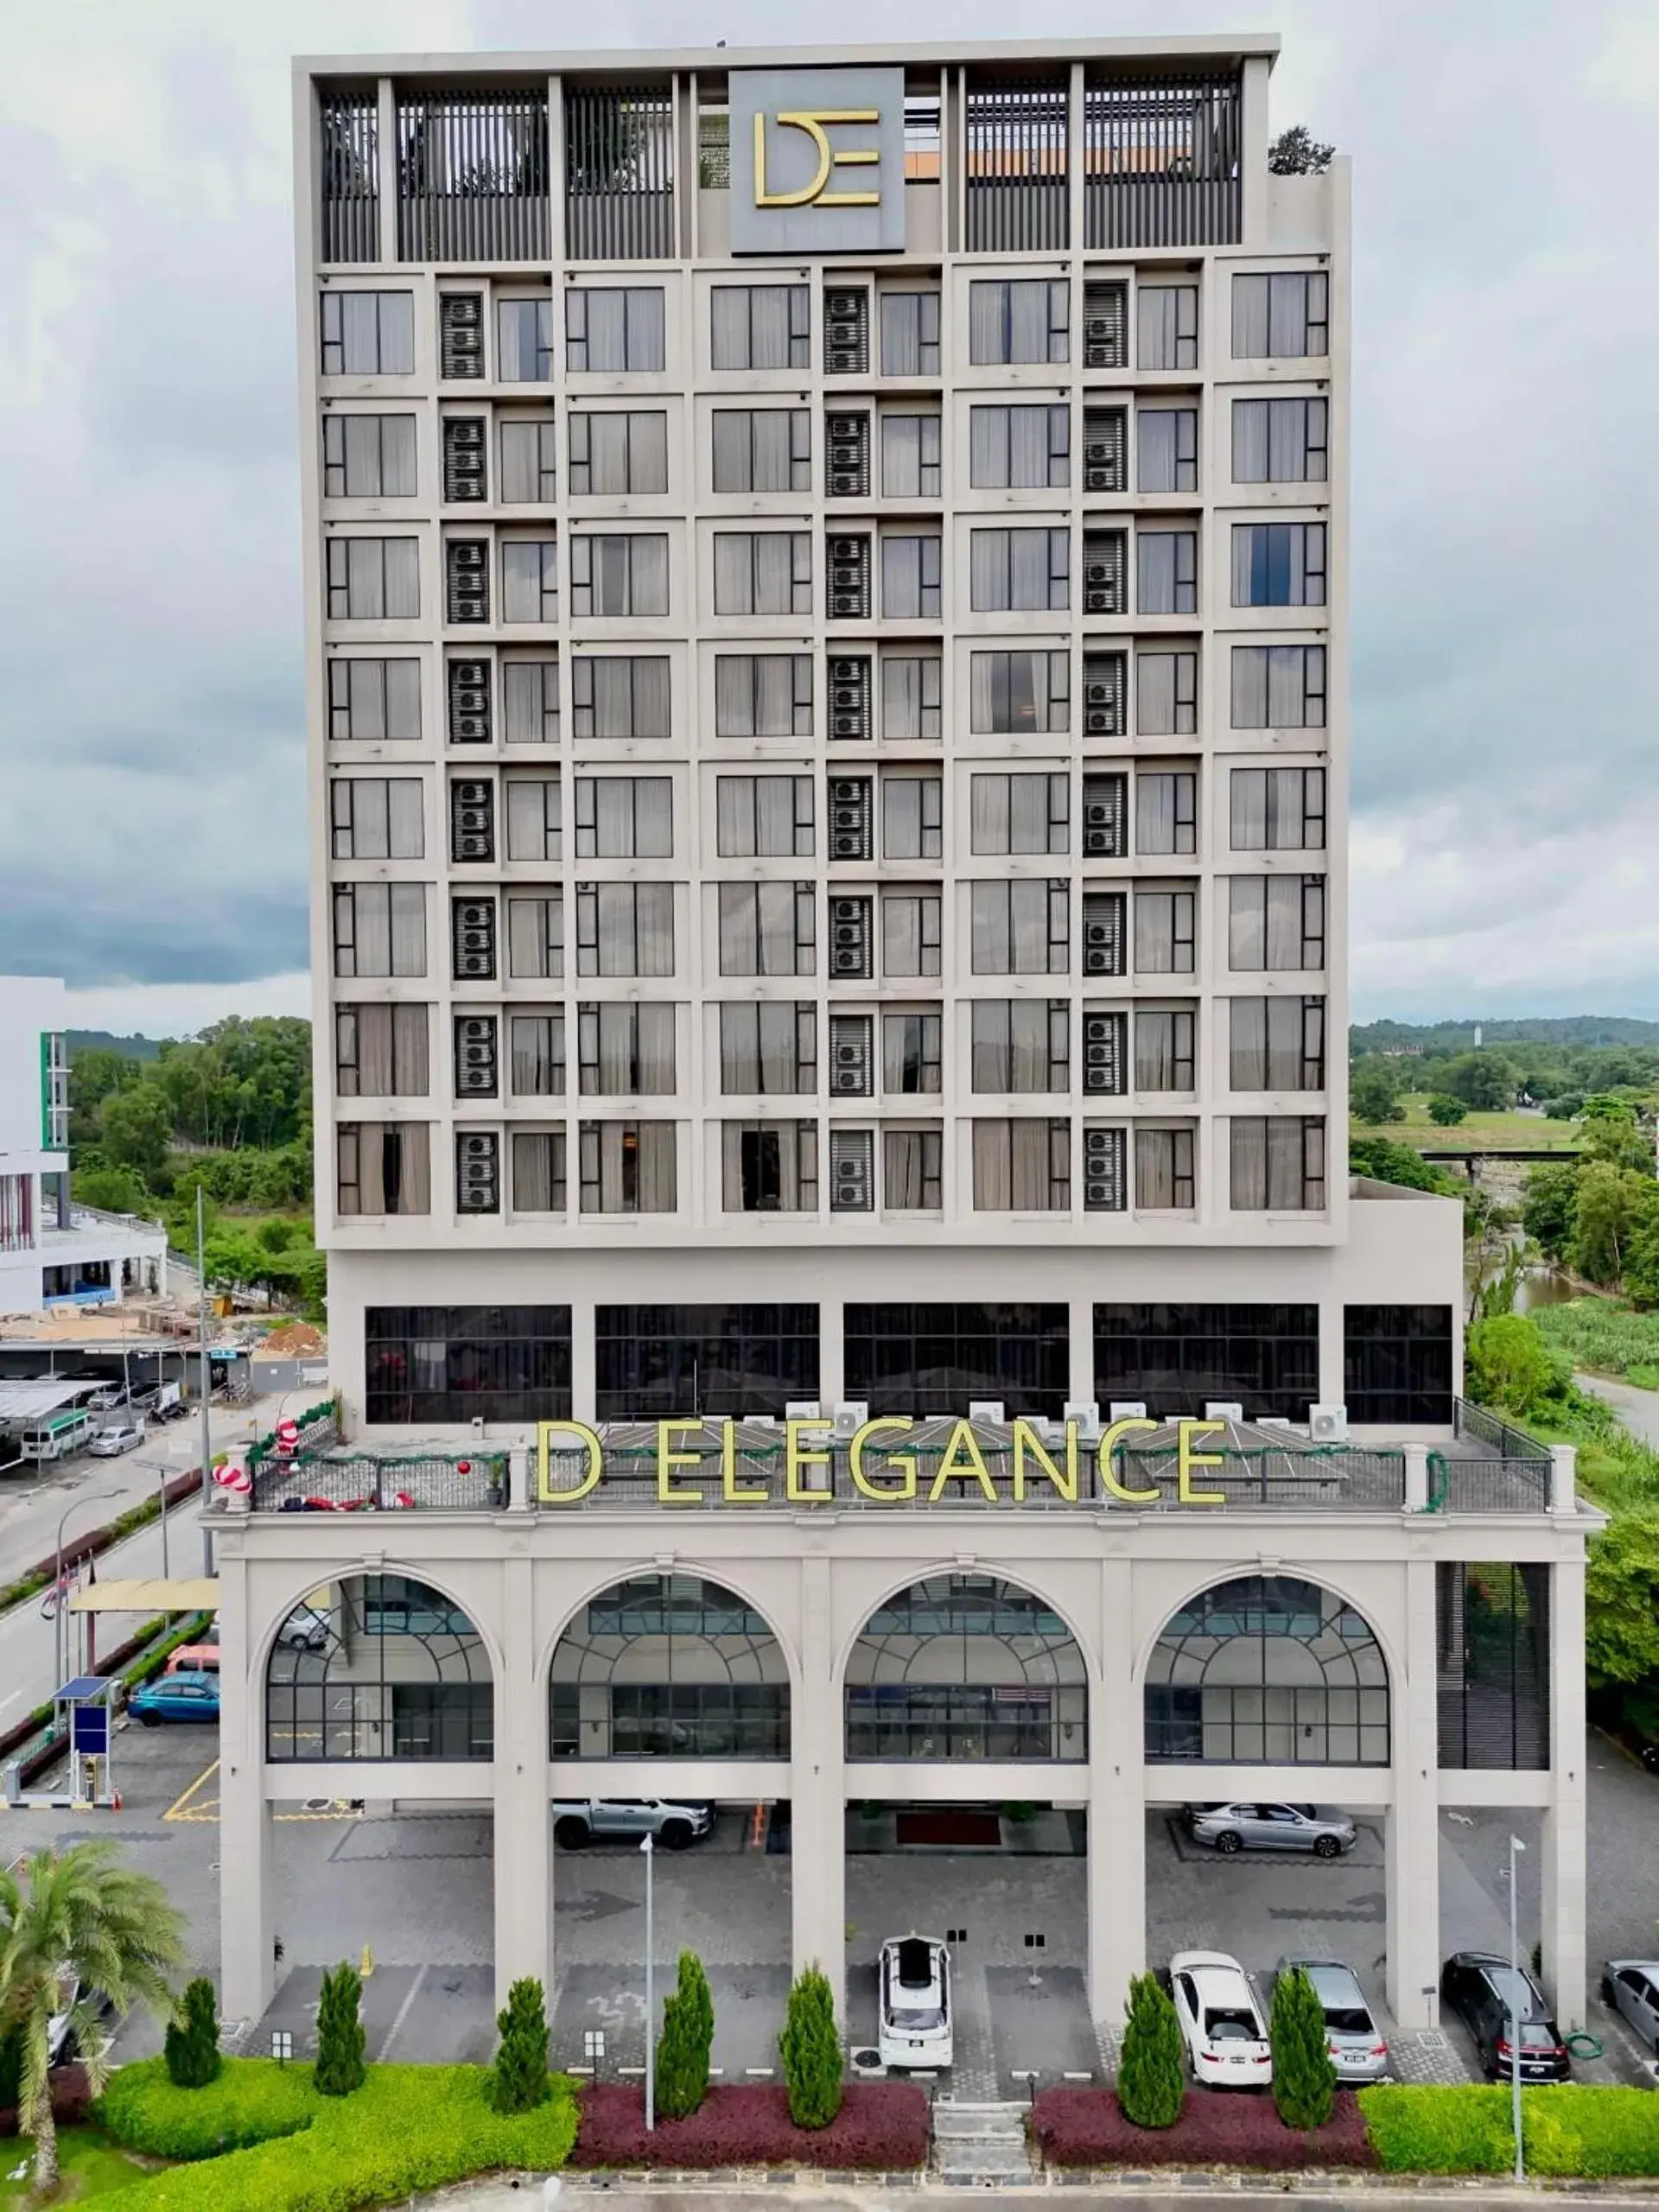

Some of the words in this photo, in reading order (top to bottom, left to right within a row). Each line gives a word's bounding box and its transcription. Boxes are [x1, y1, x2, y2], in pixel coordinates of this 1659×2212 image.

[754, 109, 880, 207] DE
[537, 1420, 602, 1503] D
[657, 1417, 1227, 1504] ELEGANCE
